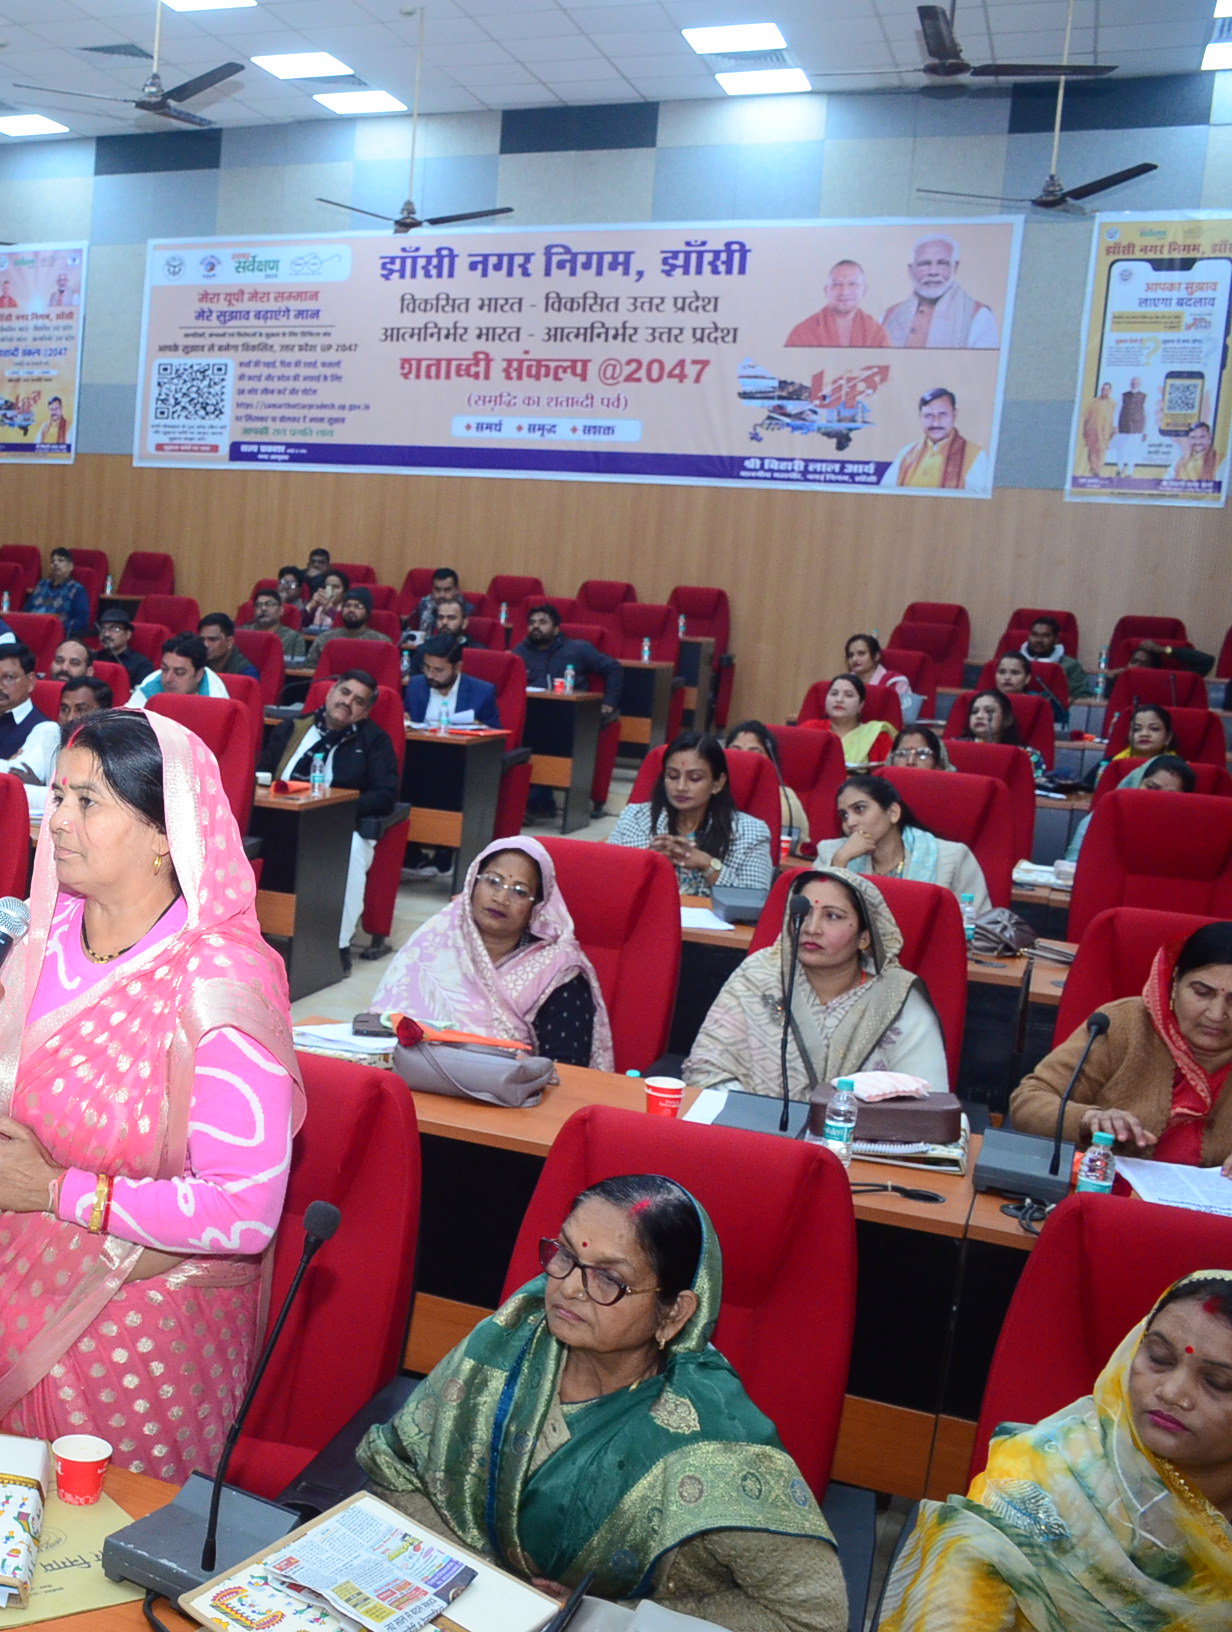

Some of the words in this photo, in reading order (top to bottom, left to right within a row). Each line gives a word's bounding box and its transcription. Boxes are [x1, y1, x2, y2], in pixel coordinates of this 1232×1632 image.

[235, 254, 280, 274] सर्वेक्षण
[467, 252, 535, 278] नगर
[543, 243, 645, 283] निगम,
[198, 290, 221, 304] मेरा
[247, 289, 271, 303] मेरा
[274, 290, 319, 303] सम्मान
[400, 292, 471, 314] विकसित
[478, 297, 524, 314] भारत
[544, 291, 620, 313] विकसित
[626, 294, 667, 313] उत्तर
[672, 290, 720, 314] प्रदेश
[194, 308, 213, 321] मेरे
[216, 309, 251, 325] सुझाव
[294, 308, 321, 321] मान
[379, 320, 470, 343] आत्मनिर्भर
[476, 325, 522, 343] भारत
[541, 320, 639, 344] आत्मनिर्भर
[645, 325, 686, 344] उत्तर
[691, 321, 739, 345] प्रदेश
[399, 350, 494, 381] शताब्दी
[502, 350, 592, 382] संकल्प
[598, 357, 711, 386] @2047
[522, 393, 541, 409] का
[546, 392, 595, 410] शताब्दी
[600, 393, 629, 411] पर्व)
[475, 420, 503, 433] समर्थ
